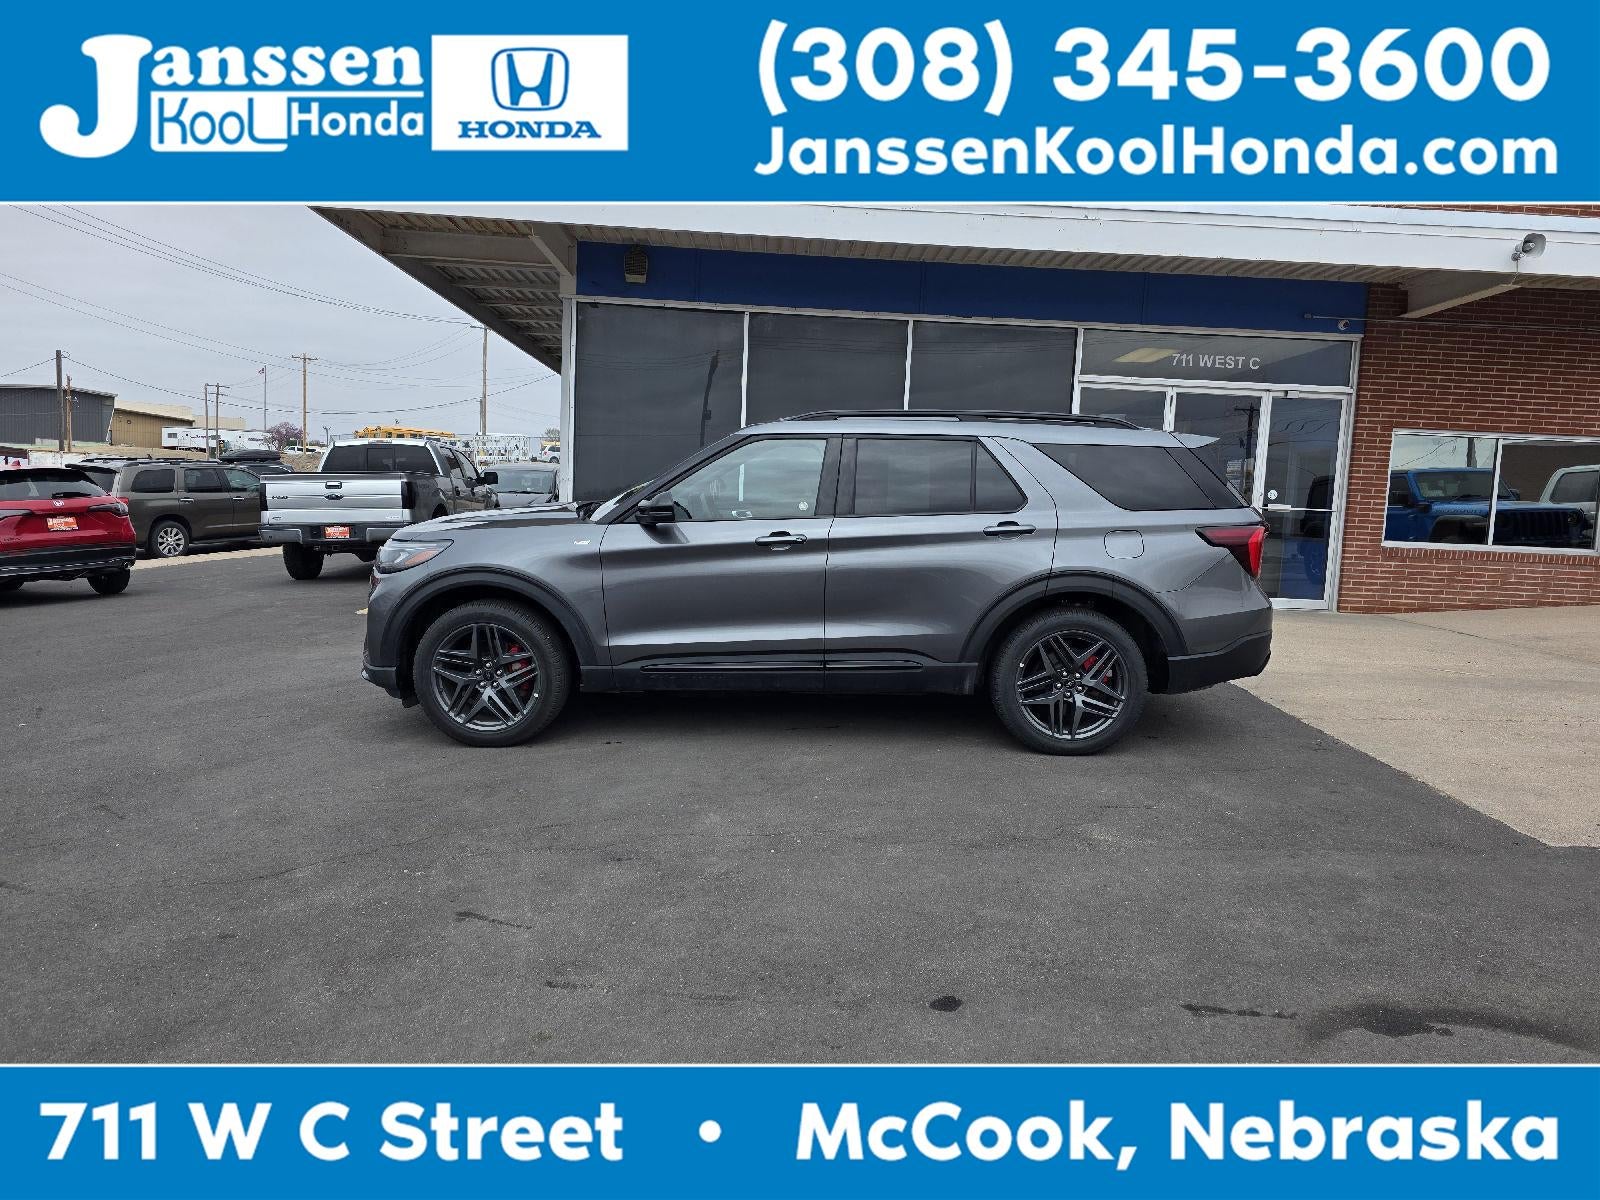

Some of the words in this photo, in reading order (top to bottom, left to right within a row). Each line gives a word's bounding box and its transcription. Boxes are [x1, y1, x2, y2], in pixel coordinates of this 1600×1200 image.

[1172, 353, 1194, 367] 711
[1199, 354, 1246, 369] WEST
[1249, 357, 1261, 370] C
